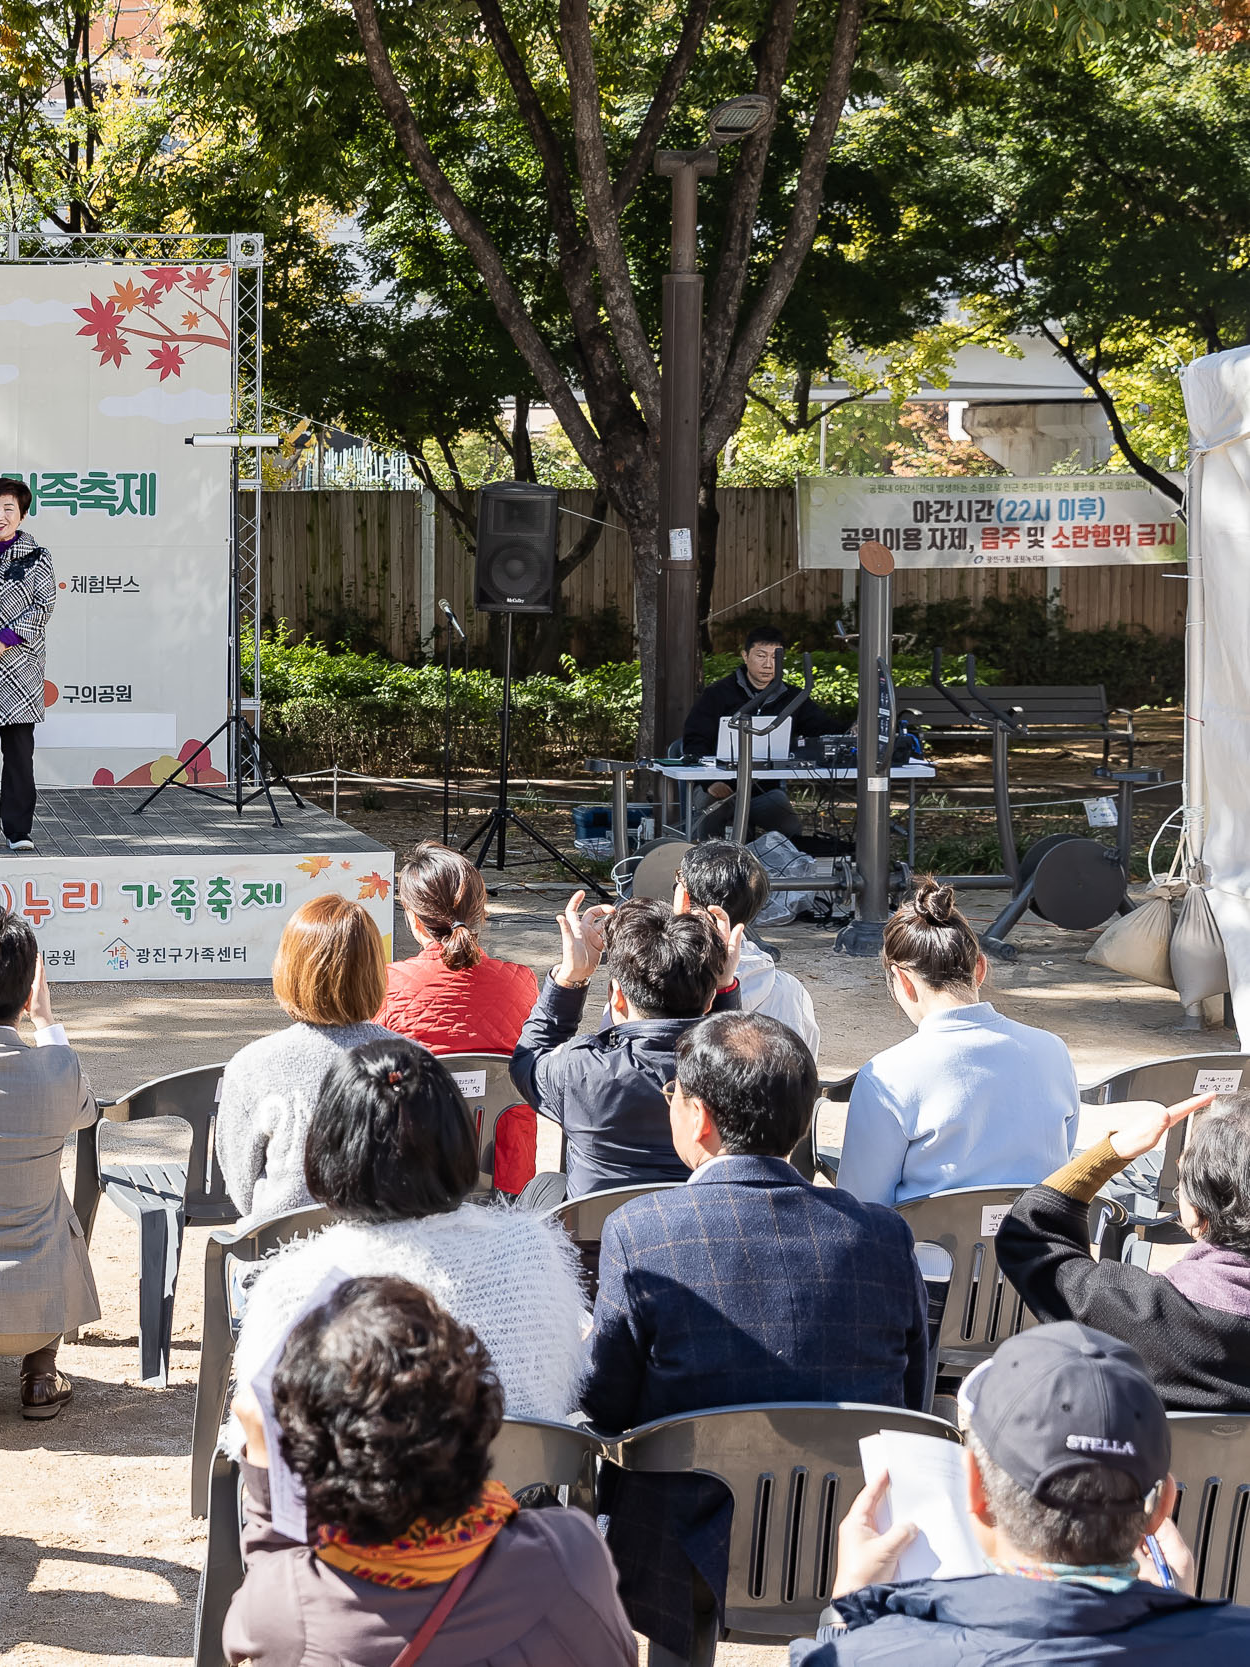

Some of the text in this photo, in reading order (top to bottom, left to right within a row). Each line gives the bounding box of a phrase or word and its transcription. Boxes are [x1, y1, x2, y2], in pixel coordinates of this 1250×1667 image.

[1058, 497, 1106, 522] 이후)
[928, 527, 975, 553] 자제,
[981, 526, 1020, 550] 음주
[1027, 526, 1045, 549] 및
[1051, 524, 1131, 548] 소란행위
[1137, 522, 1176, 547] 금지
[70, 575, 140, 594] 체험부스
[63, 684, 133, 704] 구의공원
[121, 876, 282, 921] 가족축제
[135, 946, 247, 964] 광진구가족센터
[1065, 1434, 1137, 1457] STELLA
